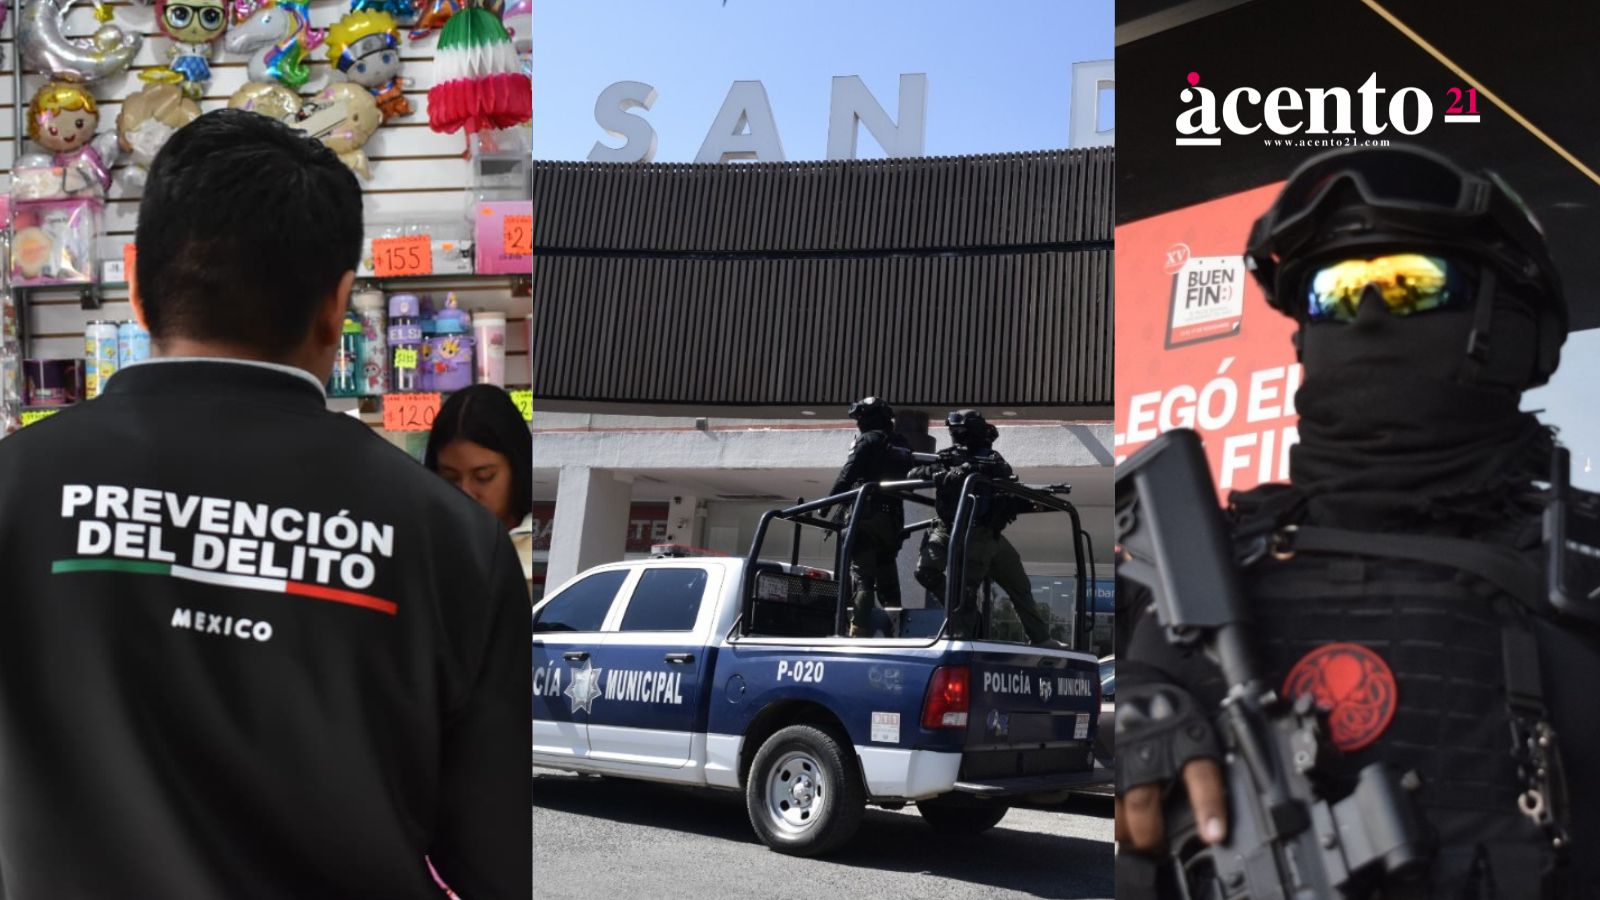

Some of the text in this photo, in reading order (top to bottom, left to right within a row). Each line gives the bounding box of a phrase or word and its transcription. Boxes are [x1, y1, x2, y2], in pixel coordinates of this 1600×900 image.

[586, 72, 928, 163] SAN
[1188, 268, 1235, 288] BUEN
[1115, 356, 1238, 446] EGÓ
[61, 484, 395, 557] PREVENCIÓN
[77, 520, 376, 590] DEL DELITO
[171, 608, 273, 642] MEXICO
[532, 661, 683, 705] CÍA MUNICIPAL
[777, 660, 824, 683] P-020
[983, 670, 1092, 697] POLICÍA MUNICIPAL
